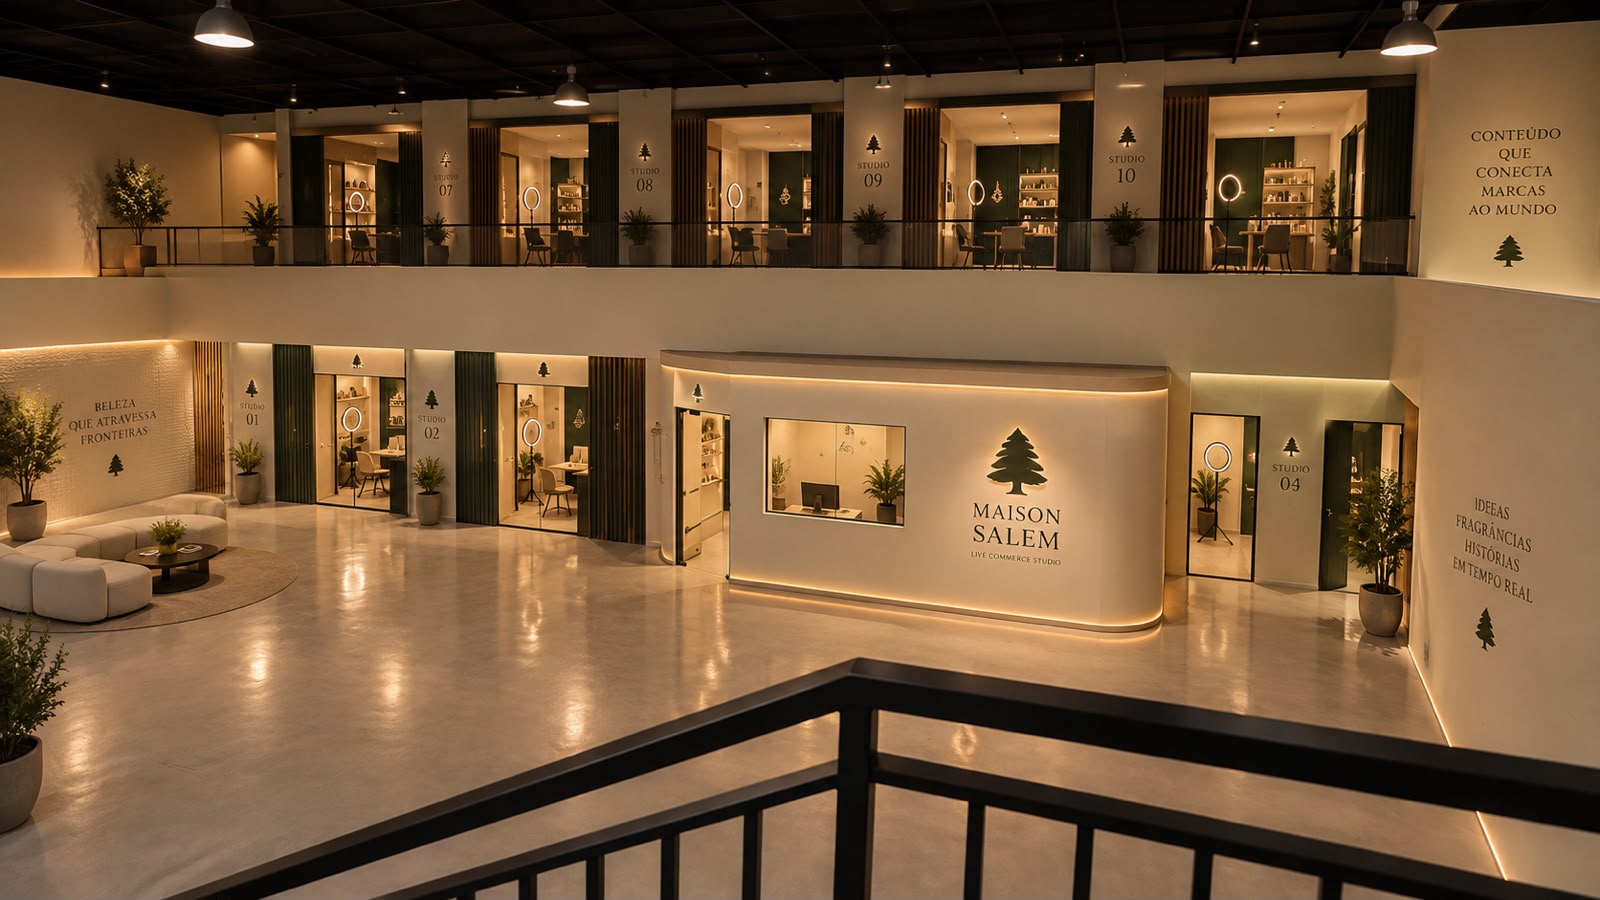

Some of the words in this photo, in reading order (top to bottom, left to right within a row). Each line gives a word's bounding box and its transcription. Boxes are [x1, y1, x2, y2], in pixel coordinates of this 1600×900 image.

[1471, 127, 1561, 142] CONTEÚDO
[1108, 155, 1145, 163] STUDIO
[1498, 148, 1531, 161] QUE
[857, 161, 890, 169] STUDIO
[1476, 166, 1553, 178] CONECTA
[864, 173, 882, 188] 09
[1117, 168, 1136, 183] 10
[439, 184, 453, 196] 07
[636, 178, 653, 192] 08
[1481, 185, 1546, 197] MARCAS
[1469, 205, 1491, 216] AO
[1495, 204, 1557, 216] MUNDO
[95, 399, 136, 412] BELEZA
[68, 418, 93, 432] QUE
[96, 410, 157, 428] ATRAVESSA
[246, 412, 258, 426] 01
[417, 415, 446, 423] STUDIO
[80, 426, 148, 445] FRONTEIRAS
[424, 427, 439, 440] 02
[1272, 464, 1310, 473] STUDIO
[1280, 476, 1300, 492] 04
[973, 502, 1061, 525] MAISON
[1474, 497, 1510, 520] IDEEAS
[973, 524, 1059, 550] SALEM
[1456, 514, 1532, 553] FRAGRÂNCIAS
[970, 551, 986, 559] LIVE
[988, 553, 1030, 563] COMMERCE
[1033, 557, 1061, 566] STUDIO
[1464, 539, 1520, 573] HISTÓRIAS
[1453, 556, 1465, 573] EM
[1467, 562, 1501, 589] TEMPO
[1504, 578, 1533, 604] REAL
